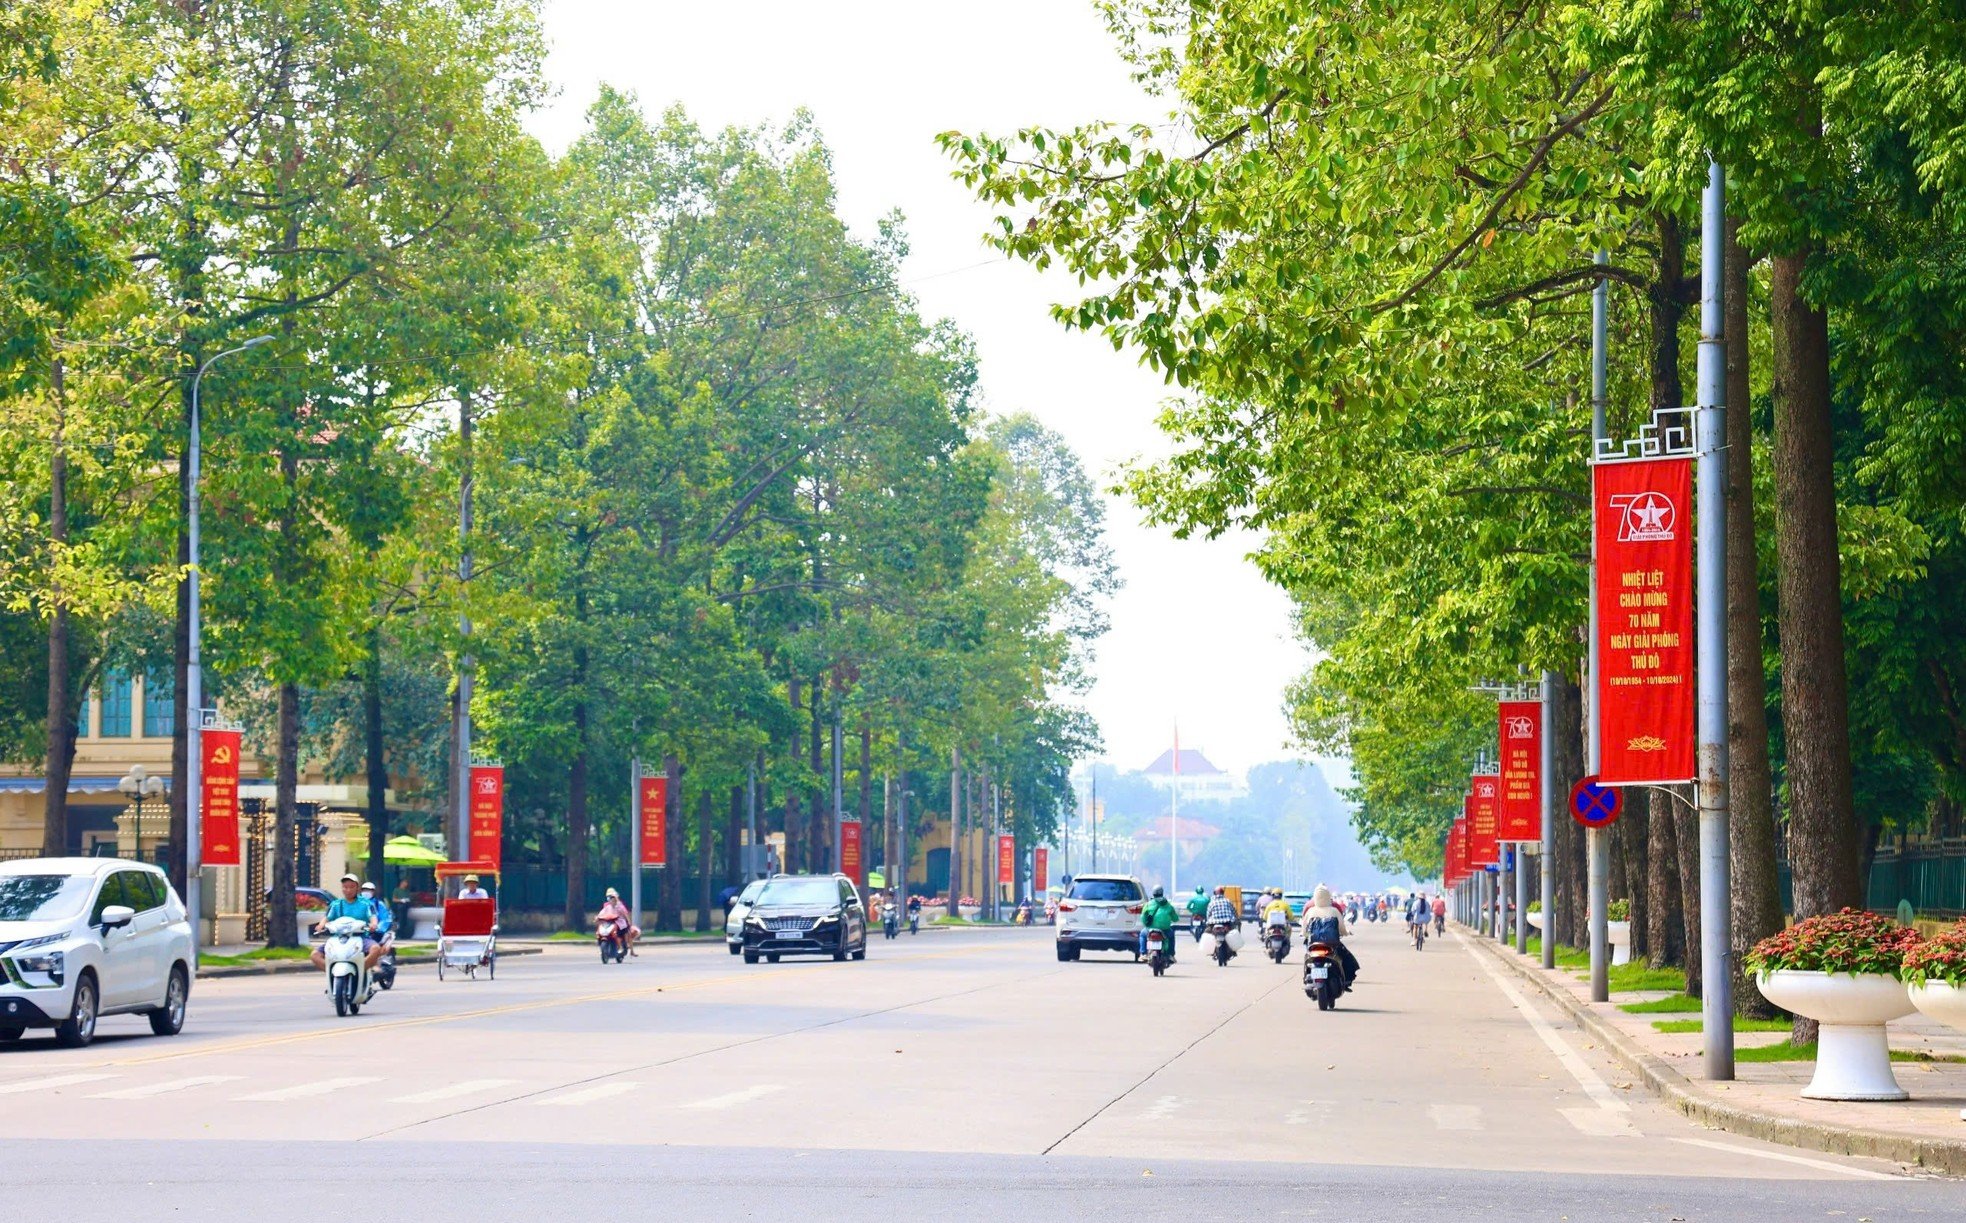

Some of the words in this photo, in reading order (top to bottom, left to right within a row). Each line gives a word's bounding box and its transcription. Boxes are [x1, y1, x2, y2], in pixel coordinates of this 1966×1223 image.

[1622, 570, 1645, 589] NHIỆT
[1647, 569, 1664, 589] LIỆT
[1620, 591, 1641, 608] CHÀO
[1643, 590, 1668, 607] MỪNG
[1628, 614, 1639, 628] 70
[1641, 610, 1660, 627] NĂM
[1610, 632, 1631, 649] NGÀY
[1633, 630, 1650, 648] GIẢI
[1651, 630, 1679, 648] PHÓNG
[1631, 650, 1647, 669] THỦ
[1648, 652, 1660, 668] ĐÔ
